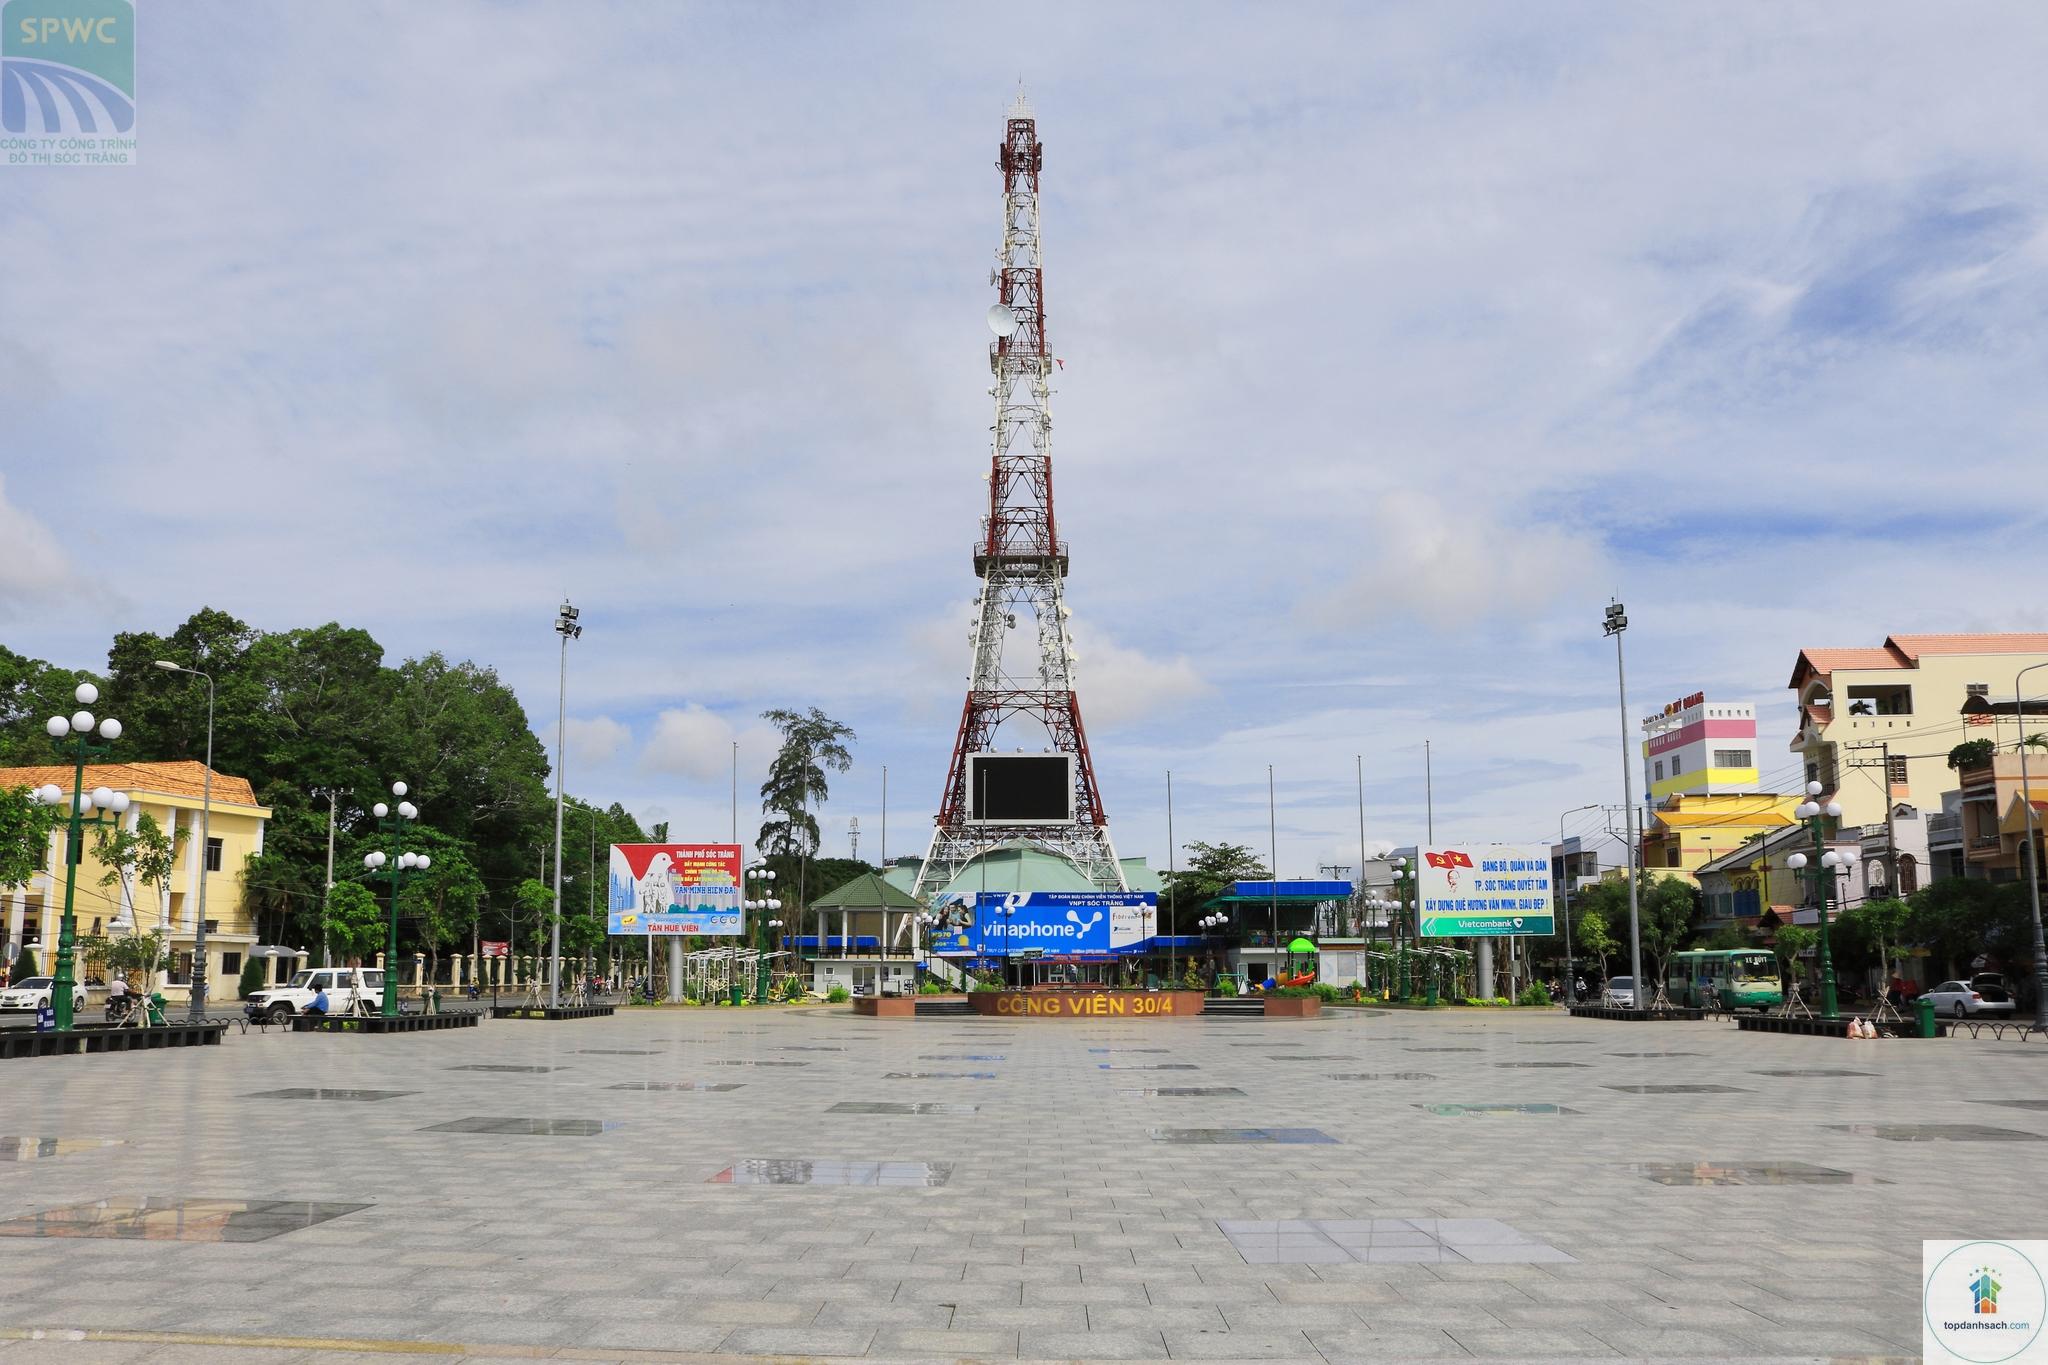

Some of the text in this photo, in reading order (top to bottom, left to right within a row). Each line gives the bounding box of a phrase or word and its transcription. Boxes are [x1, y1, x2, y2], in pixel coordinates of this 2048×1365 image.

[983, 920, 1075, 939] vinaphone
[1458, 919, 1512, 928] Vietcombank
[997, 993, 1173, 1015] CÔNG VIÊN 30/4
